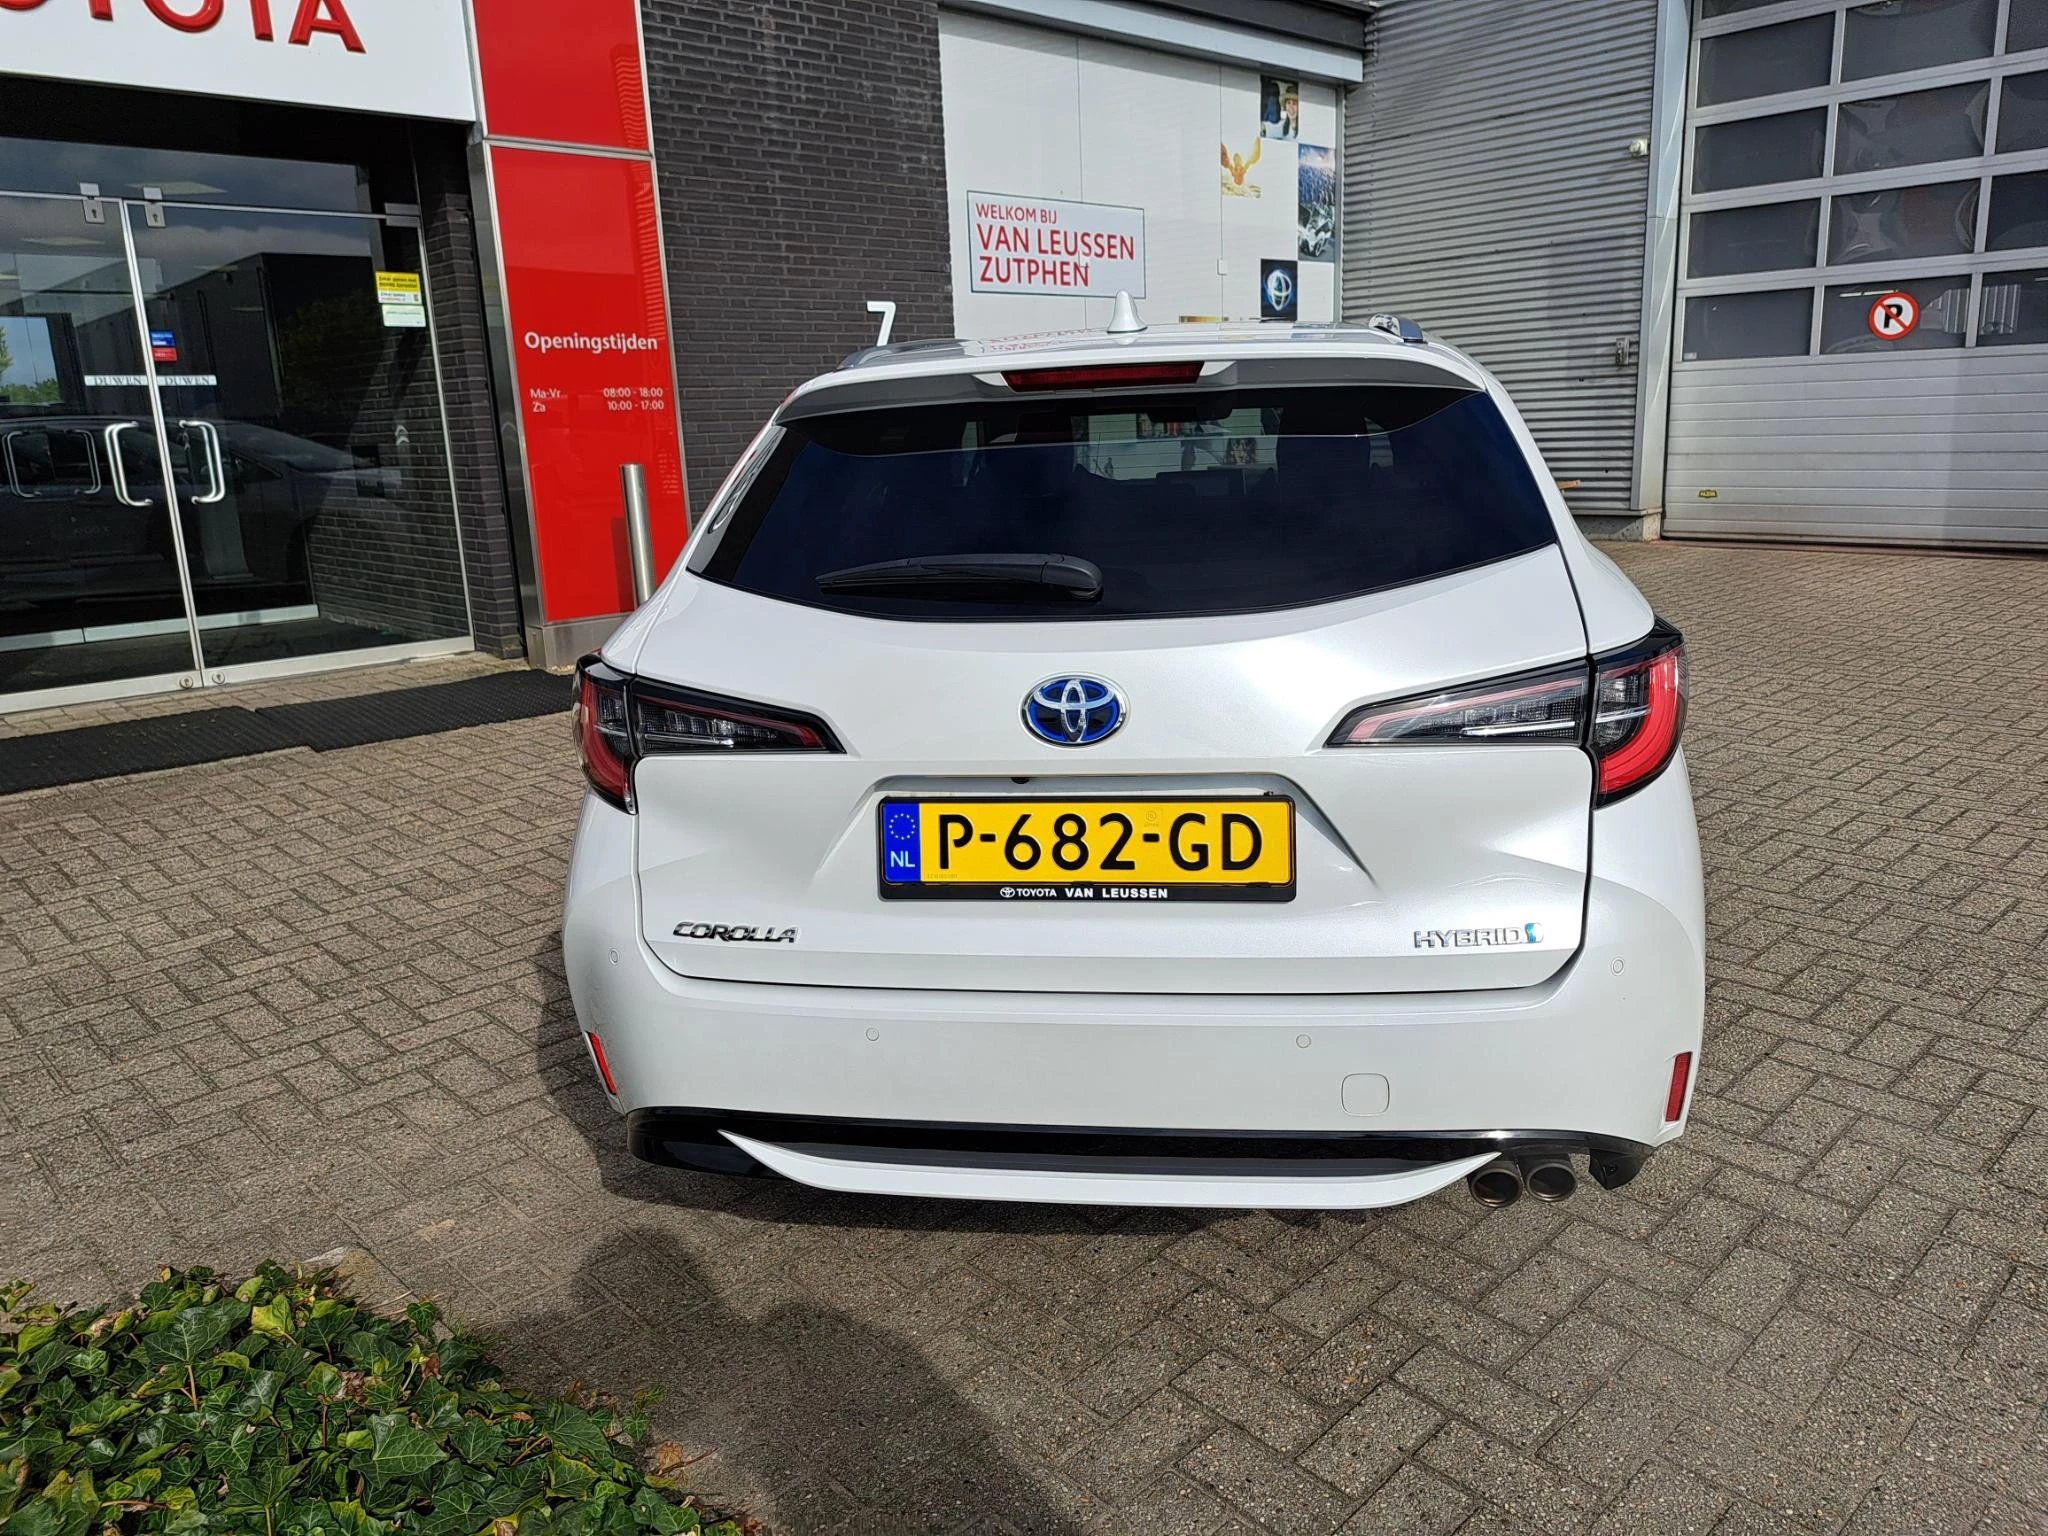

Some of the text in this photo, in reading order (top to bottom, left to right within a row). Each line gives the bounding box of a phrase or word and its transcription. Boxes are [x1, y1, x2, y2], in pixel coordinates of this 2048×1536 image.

[976, 203, 1057, 224] WELKOM BIJ
[977, 223, 1134, 260] VAN LEUSSEN
[979, 256, 1089, 287] ZUTPHEN
[867, 301, 896, 347] 7
[524, 331, 658, 354] Openingstijden
[603, 387, 631, 398] 08:00
[640, 387, 663, 398] 18:00
[532, 402, 546, 413] Za
[607, 401, 632, 410] 10:00
[641, 401, 664, 410] 17:00
[939, 813, 1262, 871] P-682-GD
[890, 850, 915, 867] NL
[1016, 888, 1168, 898] TOYOTA VAN LEUSSEN
[673, 921, 798, 943] COROLLA
[1413, 927, 1522, 948] HYBRID
